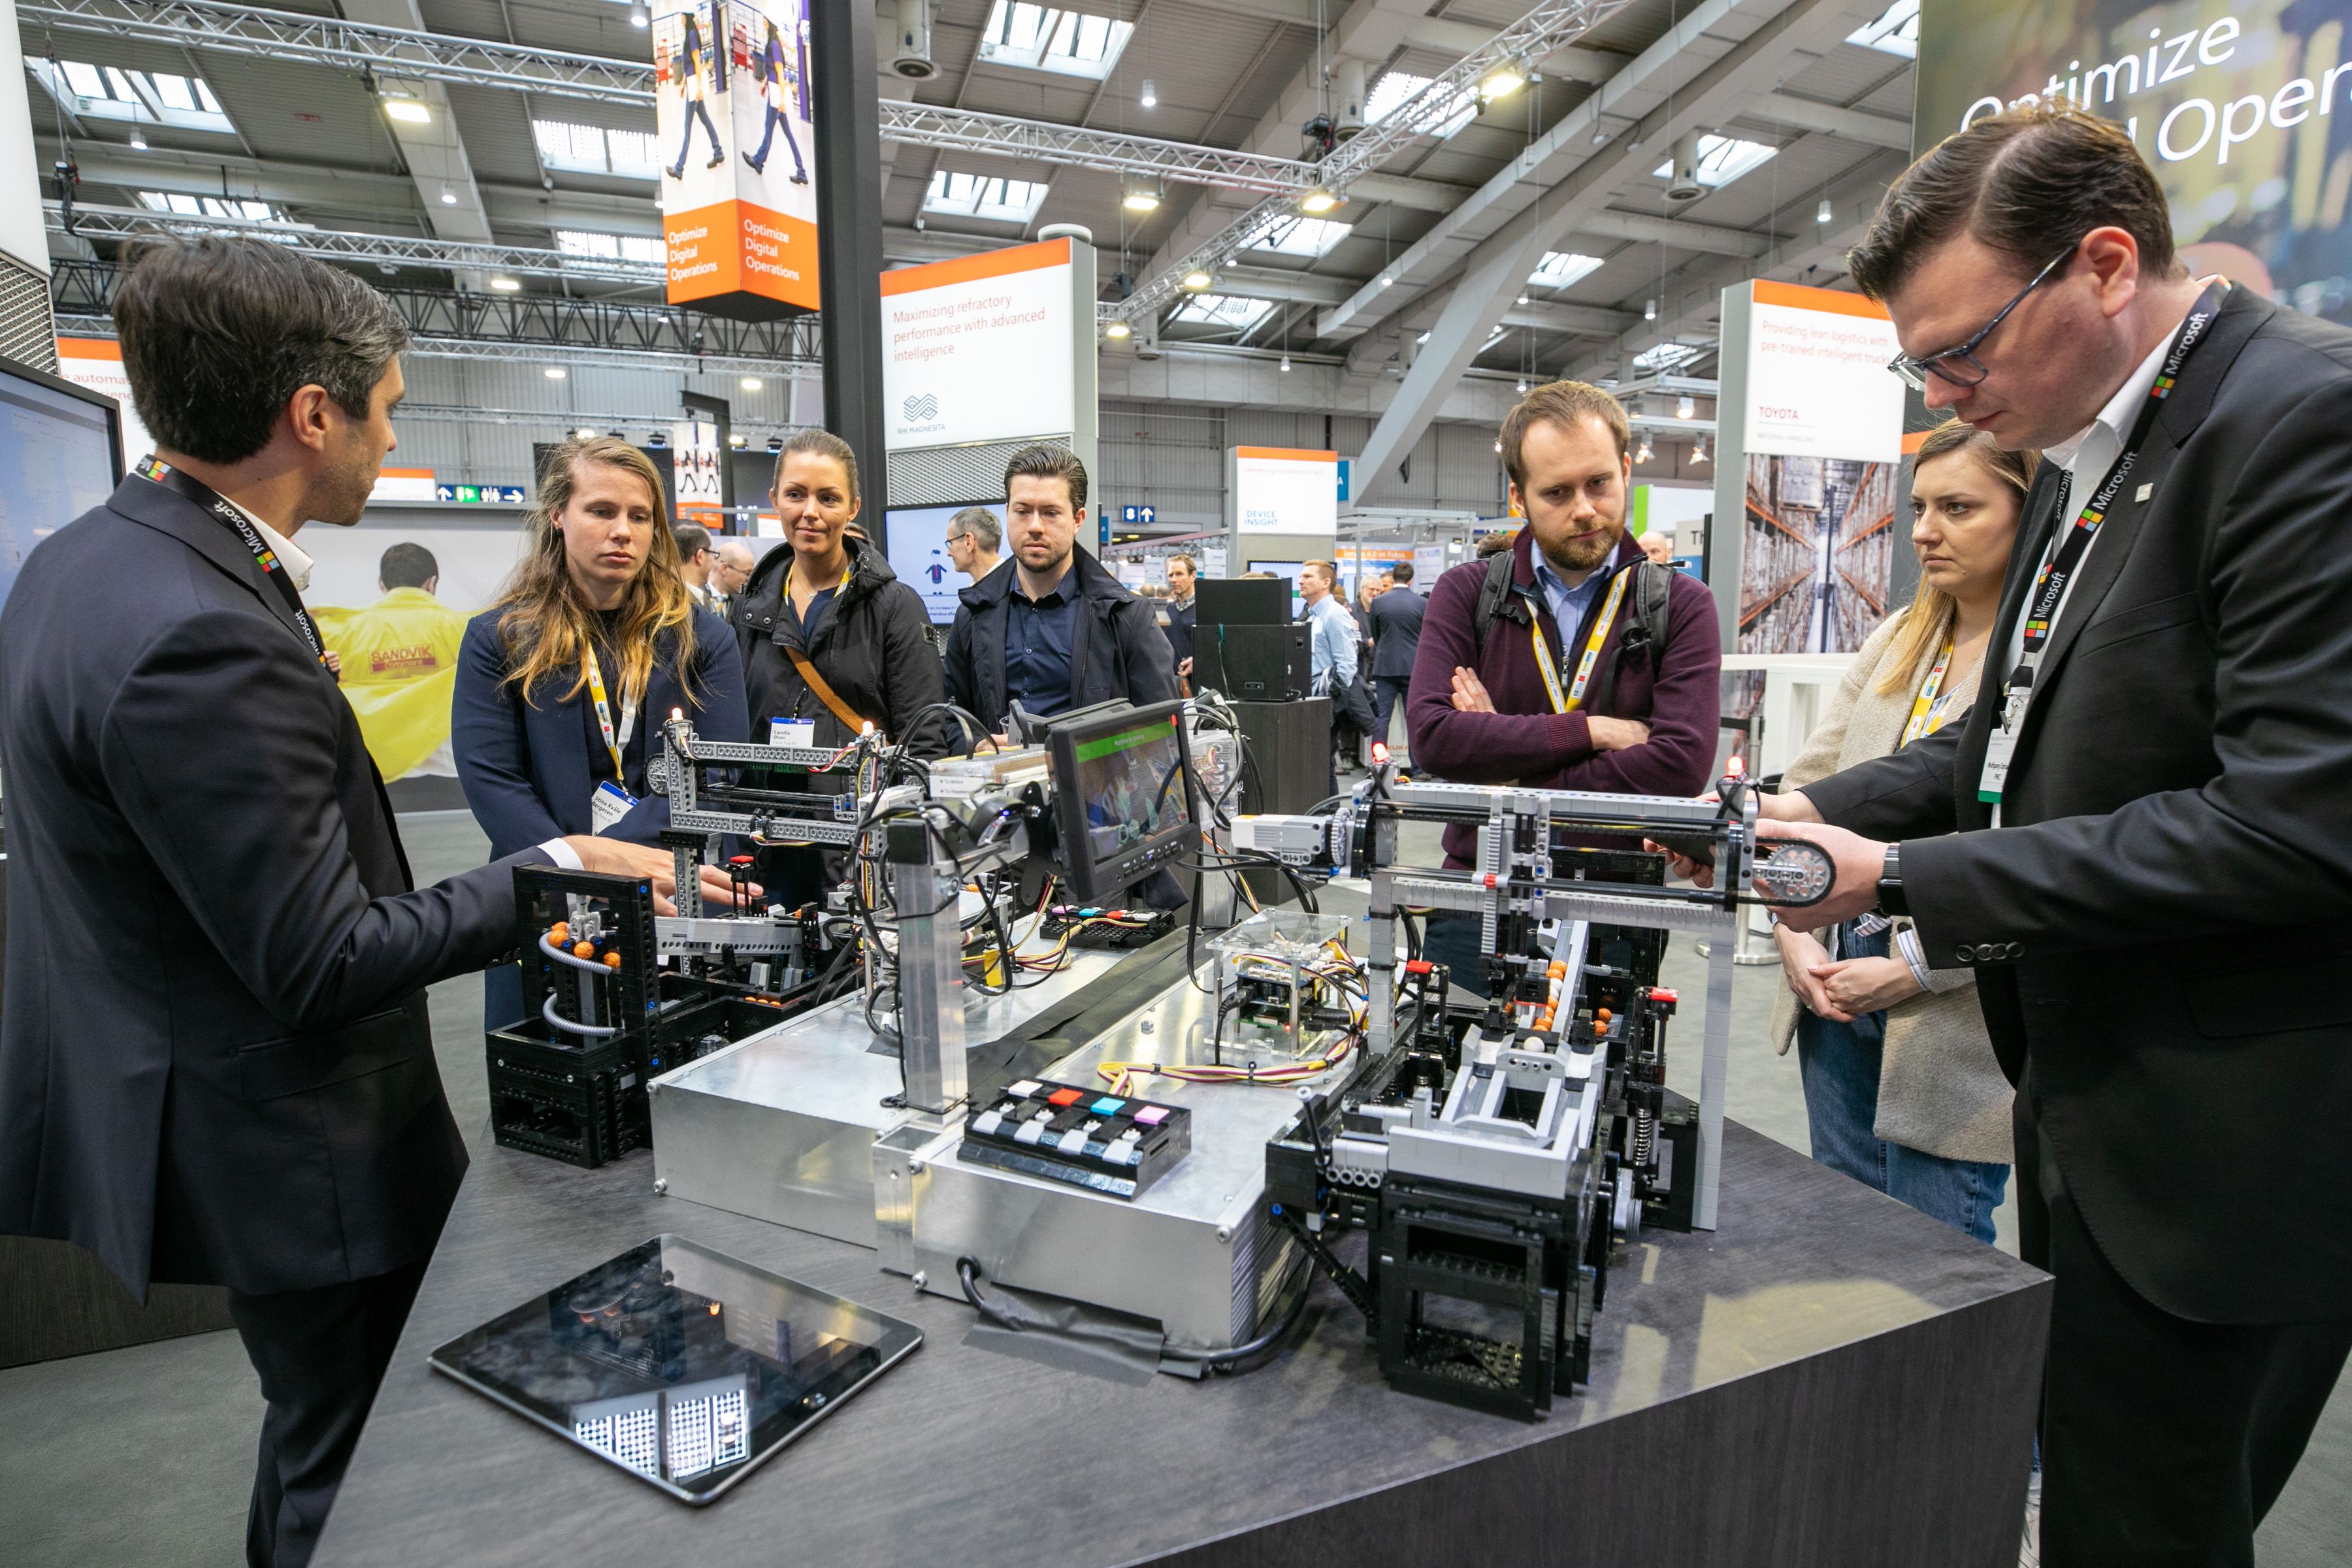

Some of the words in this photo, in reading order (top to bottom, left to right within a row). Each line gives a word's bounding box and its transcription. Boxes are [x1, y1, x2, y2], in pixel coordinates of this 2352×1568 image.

[1960, 16, 2240, 134] timize
[2157, 61, 2352, 165] Oper
[668, 226, 708, 244] Optimize
[744, 219, 789, 243] Optimize
[670, 245, 698, 264] Digital
[745, 237, 778, 257] Digital
[670, 261, 717, 282] Operations
[746, 255, 800, 282] Operations
[894, 304, 954, 323] Maximizing
[958, 295, 1012, 315] refractory
[894, 323, 961, 346] performance
[964, 318, 988, 331] with
[991, 307, 1045, 328] advanced
[1763, 320, 1808, 340] Providing
[1810, 327, 1829, 339] lean
[1832, 329, 1867, 345] logistics
[1869, 336, 1889, 346] with
[894, 342, 955, 361] intelligence
[1761, 342, 1814, 356] pre-trained
[1817, 348, 1862, 363] intelligent
[2164, 311, 2209, 375] Microsoft
[1759, 406, 1799, 419] TOYOTA
[909, 423, 945, 434] MAGNESITA
[2093, 449, 2138, 510] Microsoft
[2056, 468, 2074, 521] Microsoft
[1126, 508, 1135, 519] 8
[214, 500, 264, 554] Microsoft
[2033, 571, 2066, 618] Microsoft
[371, 645, 431, 662] SANDVIK
[591, 801, 613, 817] Bergesen
[595, 796, 607, 806] Stina
[608, 802, 621, 814] Kvåle
